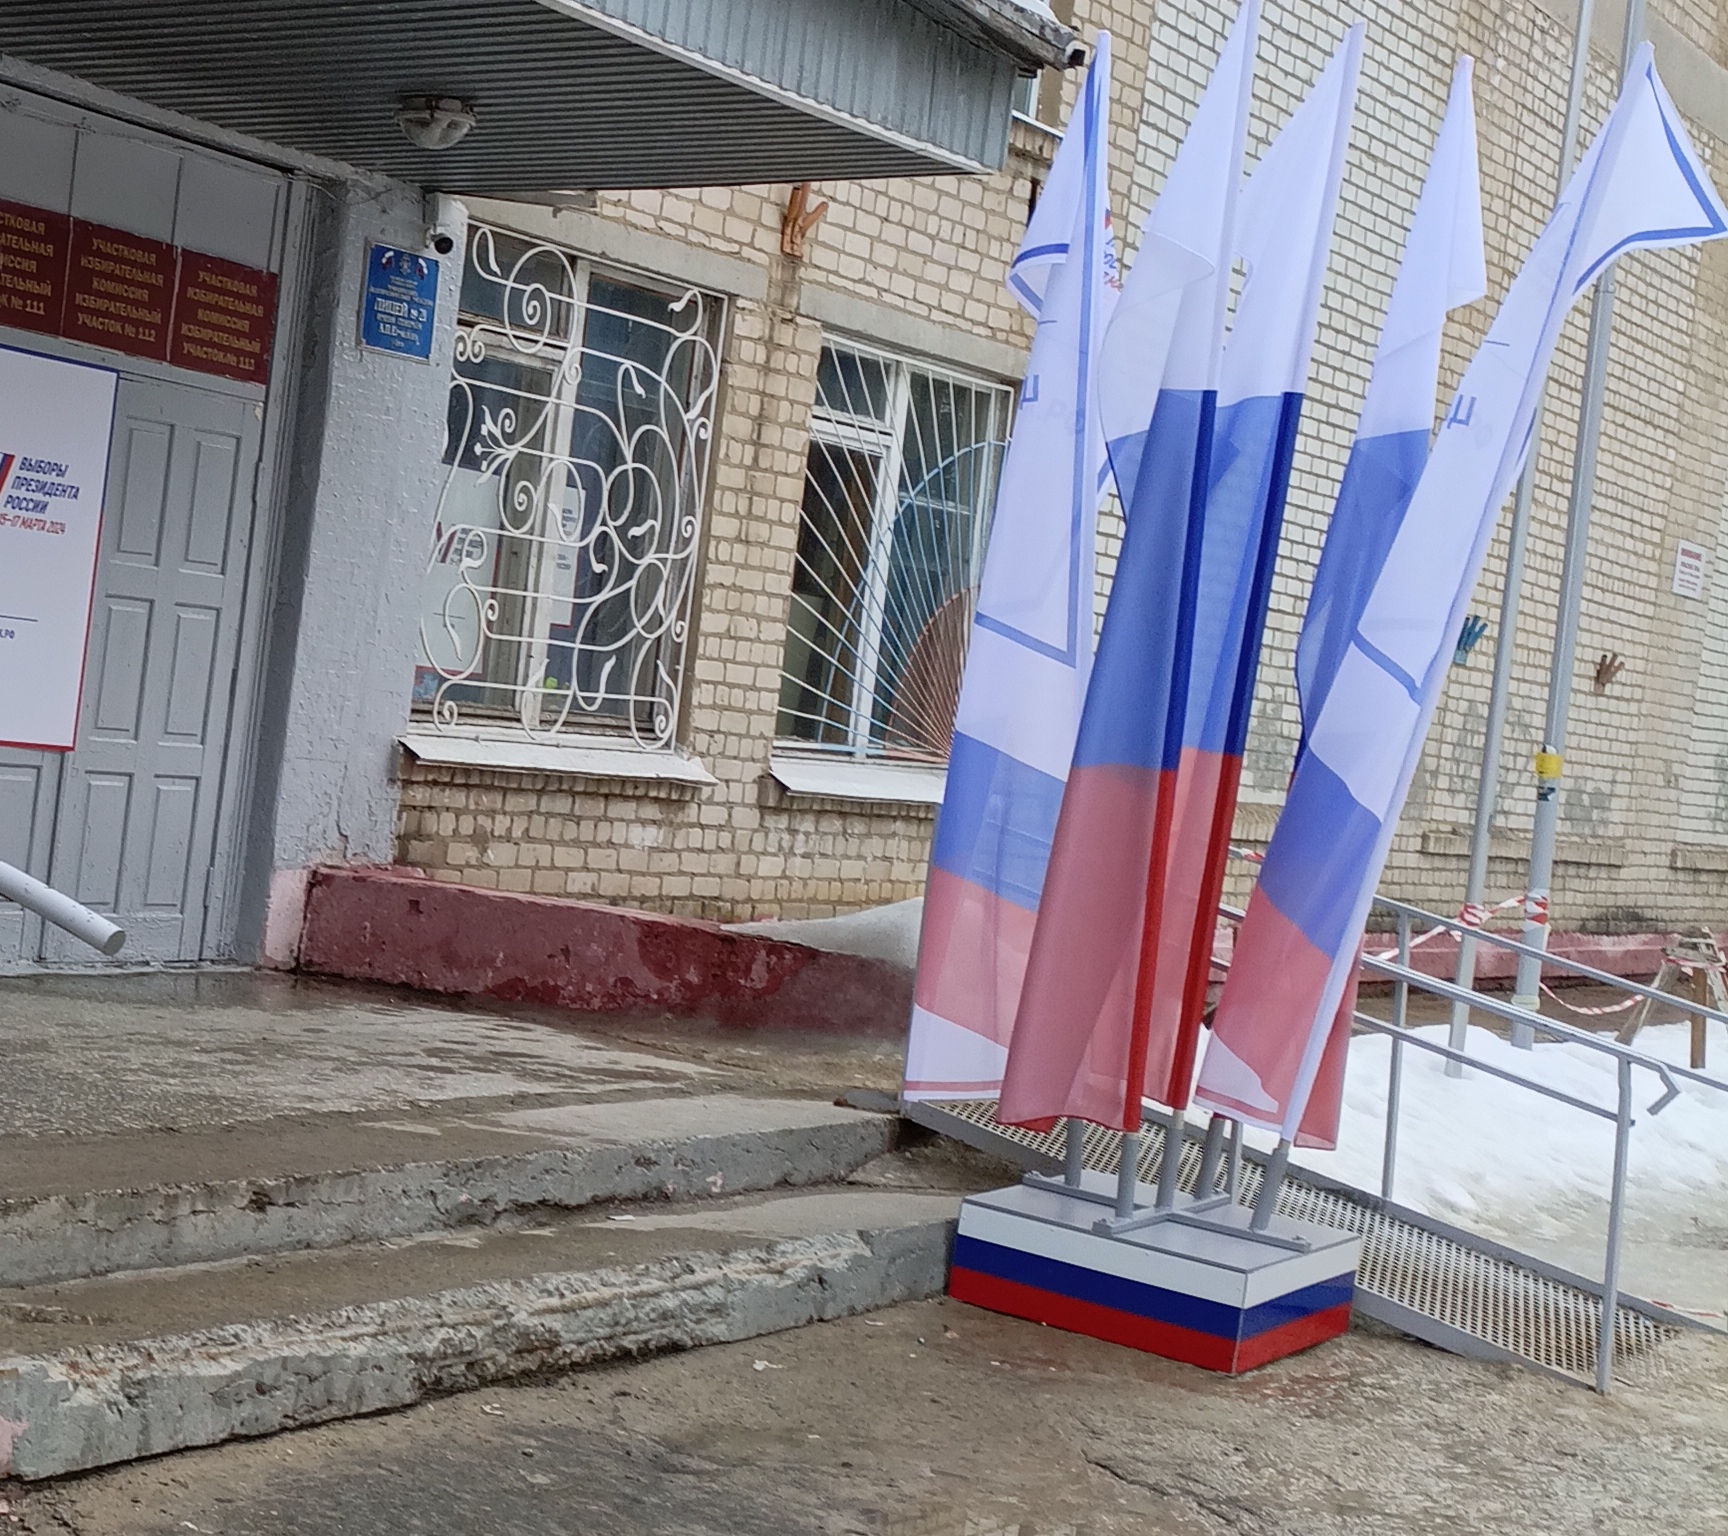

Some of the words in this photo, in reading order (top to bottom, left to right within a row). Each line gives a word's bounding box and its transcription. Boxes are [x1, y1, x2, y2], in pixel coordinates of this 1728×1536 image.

[92, 238, 157, 267] УЧАСТКОВАЯ
[80, 254, 164, 288] ИЗБИРАТЕЛЬНАЯ
[197, 270, 258, 297] УЧАСТКОВАЯ
[92, 276, 149, 302] КОМИССИЯ
[187, 286, 264, 318] ИЗБИРАТЕЛЬНАЯ
[25, 299, 46, 315] 111
[75, 292, 162, 324] ИЗБИРАТЕЛЬНЫЙ
[77, 312, 123, 334] УЧАСТОК
[137, 326, 156, 342] 112
[197, 308, 250, 333] КОМИССИЯ
[181, 322, 261, 354] ИЗБИРАТЕЛЬНЫЙ
[183, 341, 224, 363] УЧАСТОК
[19, 456, 69, 479] ВЫБОРЫ
[11, 475, 80, 501] ПРЕЗИДЕНТА
[3, 494, 49, 514] РОССИИ
[20, 516, 47, 533] МАРТА
[46, 520, 66, 535] 2024
